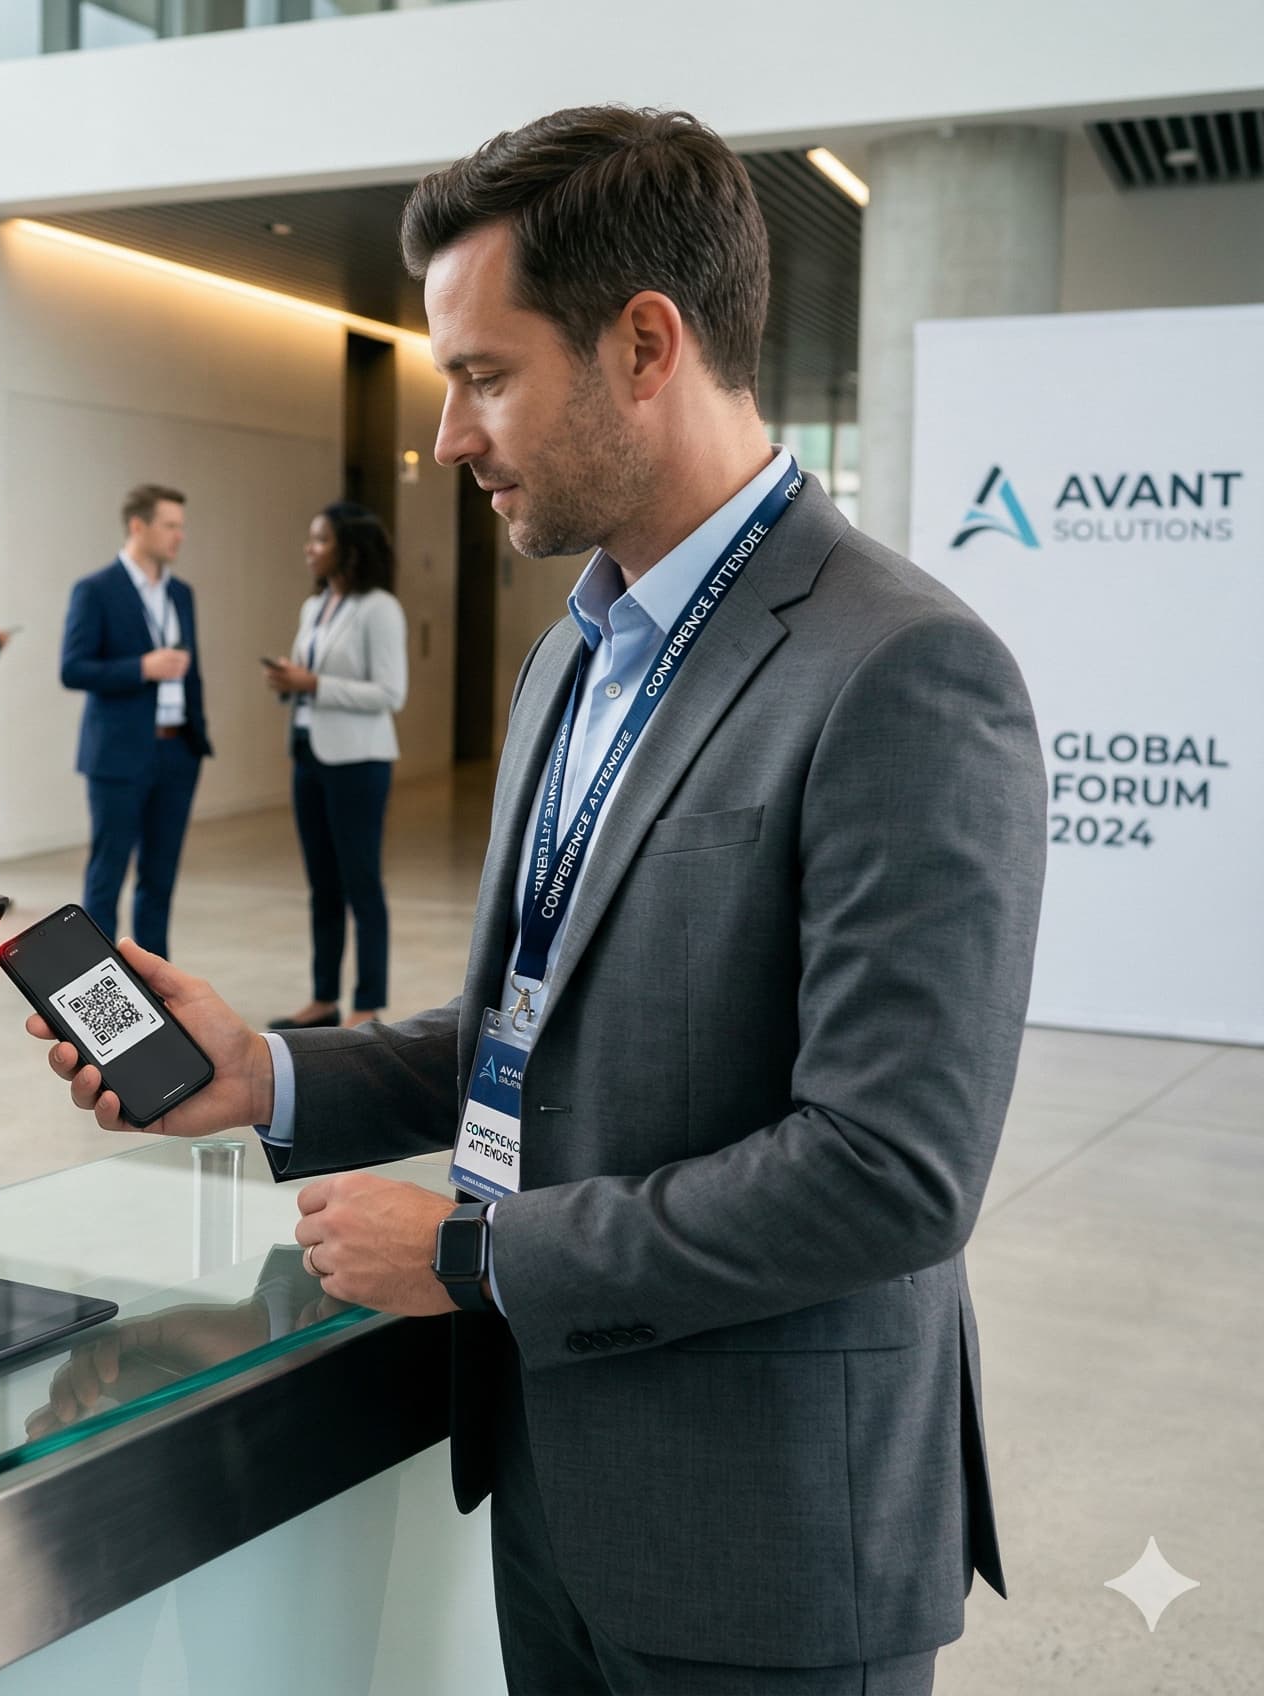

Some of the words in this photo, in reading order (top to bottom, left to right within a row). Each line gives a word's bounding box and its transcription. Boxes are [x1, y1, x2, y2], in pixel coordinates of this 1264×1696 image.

[1055, 472, 1242, 509] AVANT
[1052, 518, 1234, 542] SOLUTIONS
[645, 595, 714, 698] CONFERENCE
[707, 521, 769, 604] ATTENDEE
[1053, 732, 1229, 768] GLOBAL
[1052, 773, 1210, 810] FORUM
[541, 813, 592, 919] CONFERENCE
[589, 729, 633, 809] ATTENDEE
[1049, 815, 1154, 848] 2024
